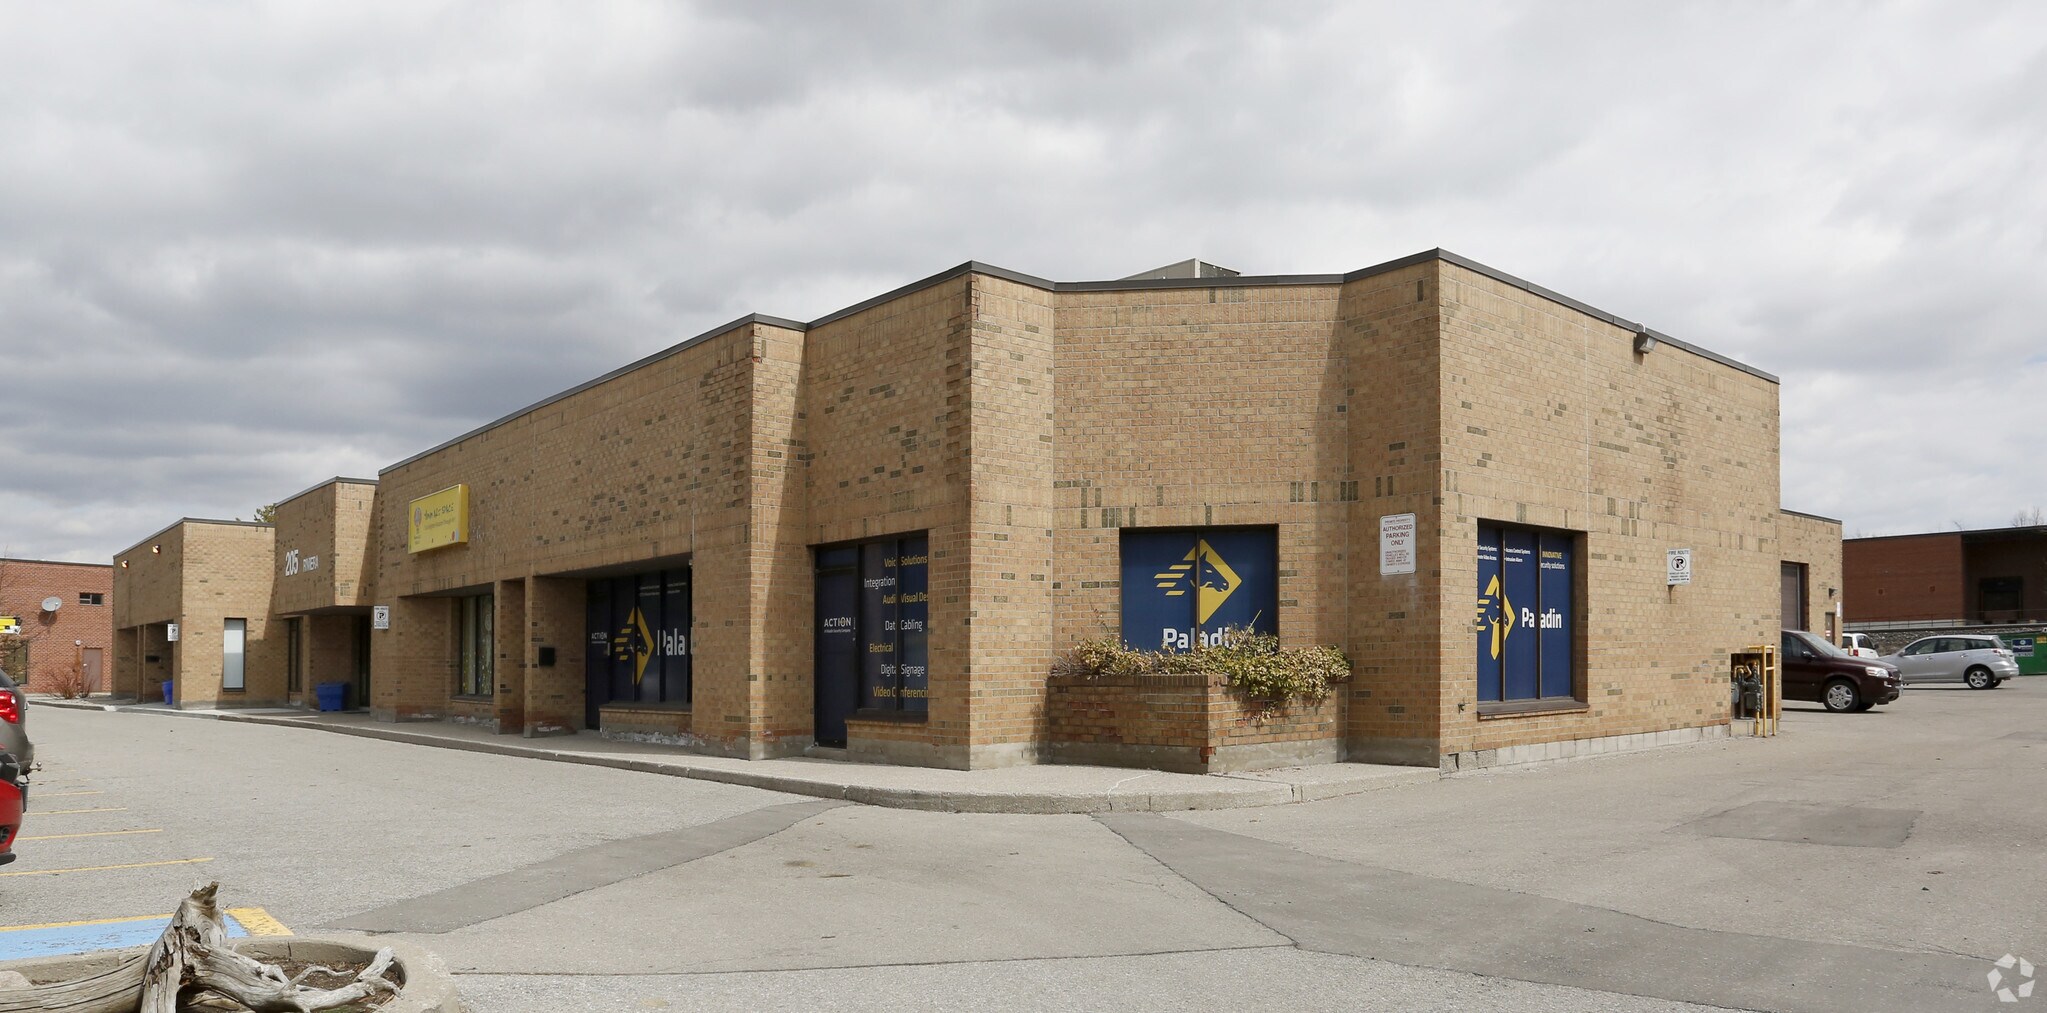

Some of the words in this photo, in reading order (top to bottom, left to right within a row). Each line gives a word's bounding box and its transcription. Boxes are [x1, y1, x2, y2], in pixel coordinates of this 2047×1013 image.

[1383, 524, 1413, 532] AUTHORIZED
[1386, 531, 1409, 539] PARKING
[285, 549, 299, 576] 205
[303, 555, 318, 573] RIVIERA
[884, 558, 897, 568] Voic
[901, 555, 928, 566] Solutions
[1540, 561, 1551, 570] ecurity
[864, 577, 895, 589] Integration
[882, 594, 897, 605] Audi
[901, 593, 918, 603] Visual
[919, 592, 928, 602] Des
[823, 616, 852, 628] ACTION
[1521, 607, 1562, 629] Paadin
[885, 620, 896, 631] Dat
[901, 619, 923, 632] Cabling
[591, 632, 608, 640] ACTION
[1162, 627, 1230, 649] Paladi
[869, 642, 894, 653] Electrical
[881, 664, 897, 677] Digita
[901, 664, 925, 677] Signage
[873, 687, 890, 698] Video
